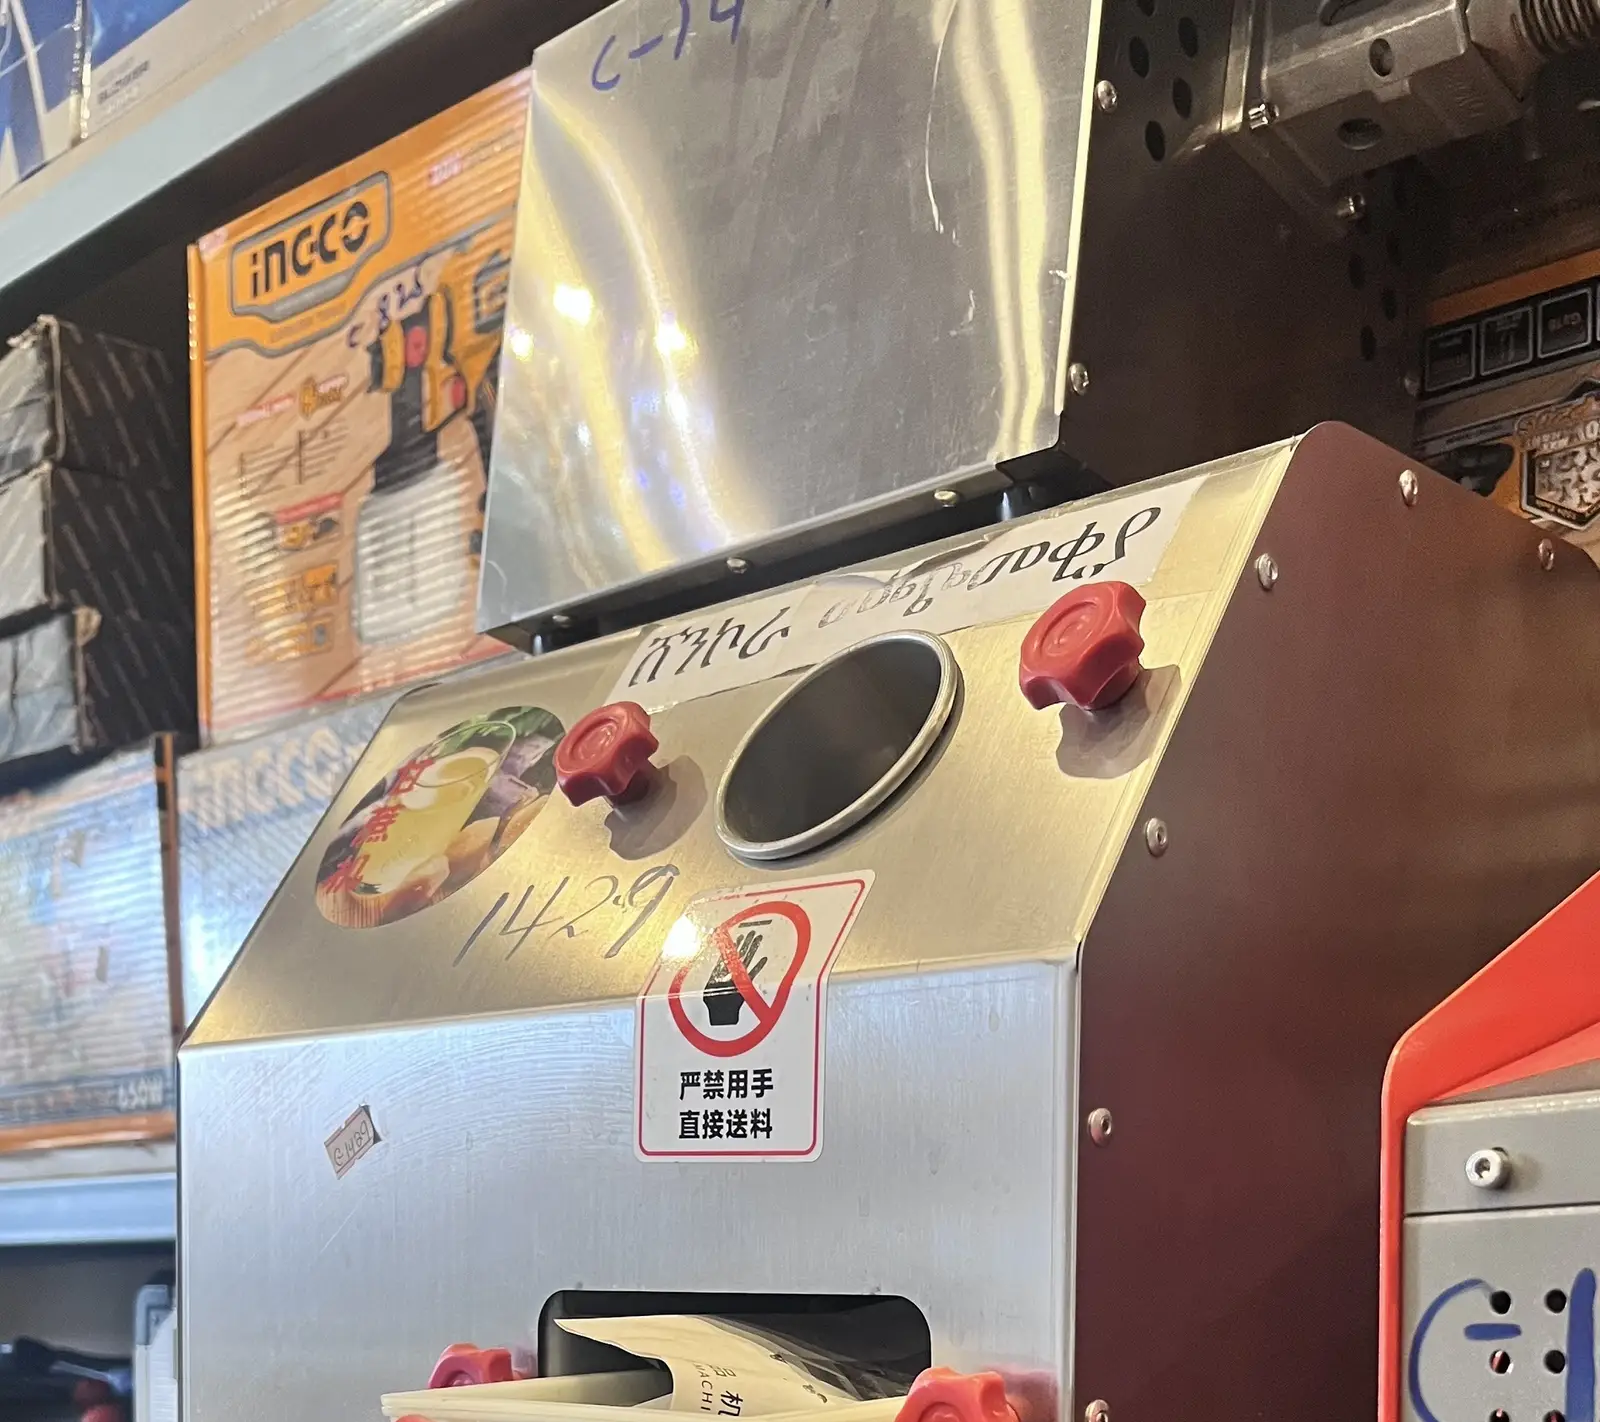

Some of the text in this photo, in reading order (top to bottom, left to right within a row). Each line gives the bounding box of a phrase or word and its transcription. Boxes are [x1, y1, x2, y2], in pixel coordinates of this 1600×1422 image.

[679, 1068, 774, 1101] 严禁用手
[679, 1107, 773, 1139] 直接送料
